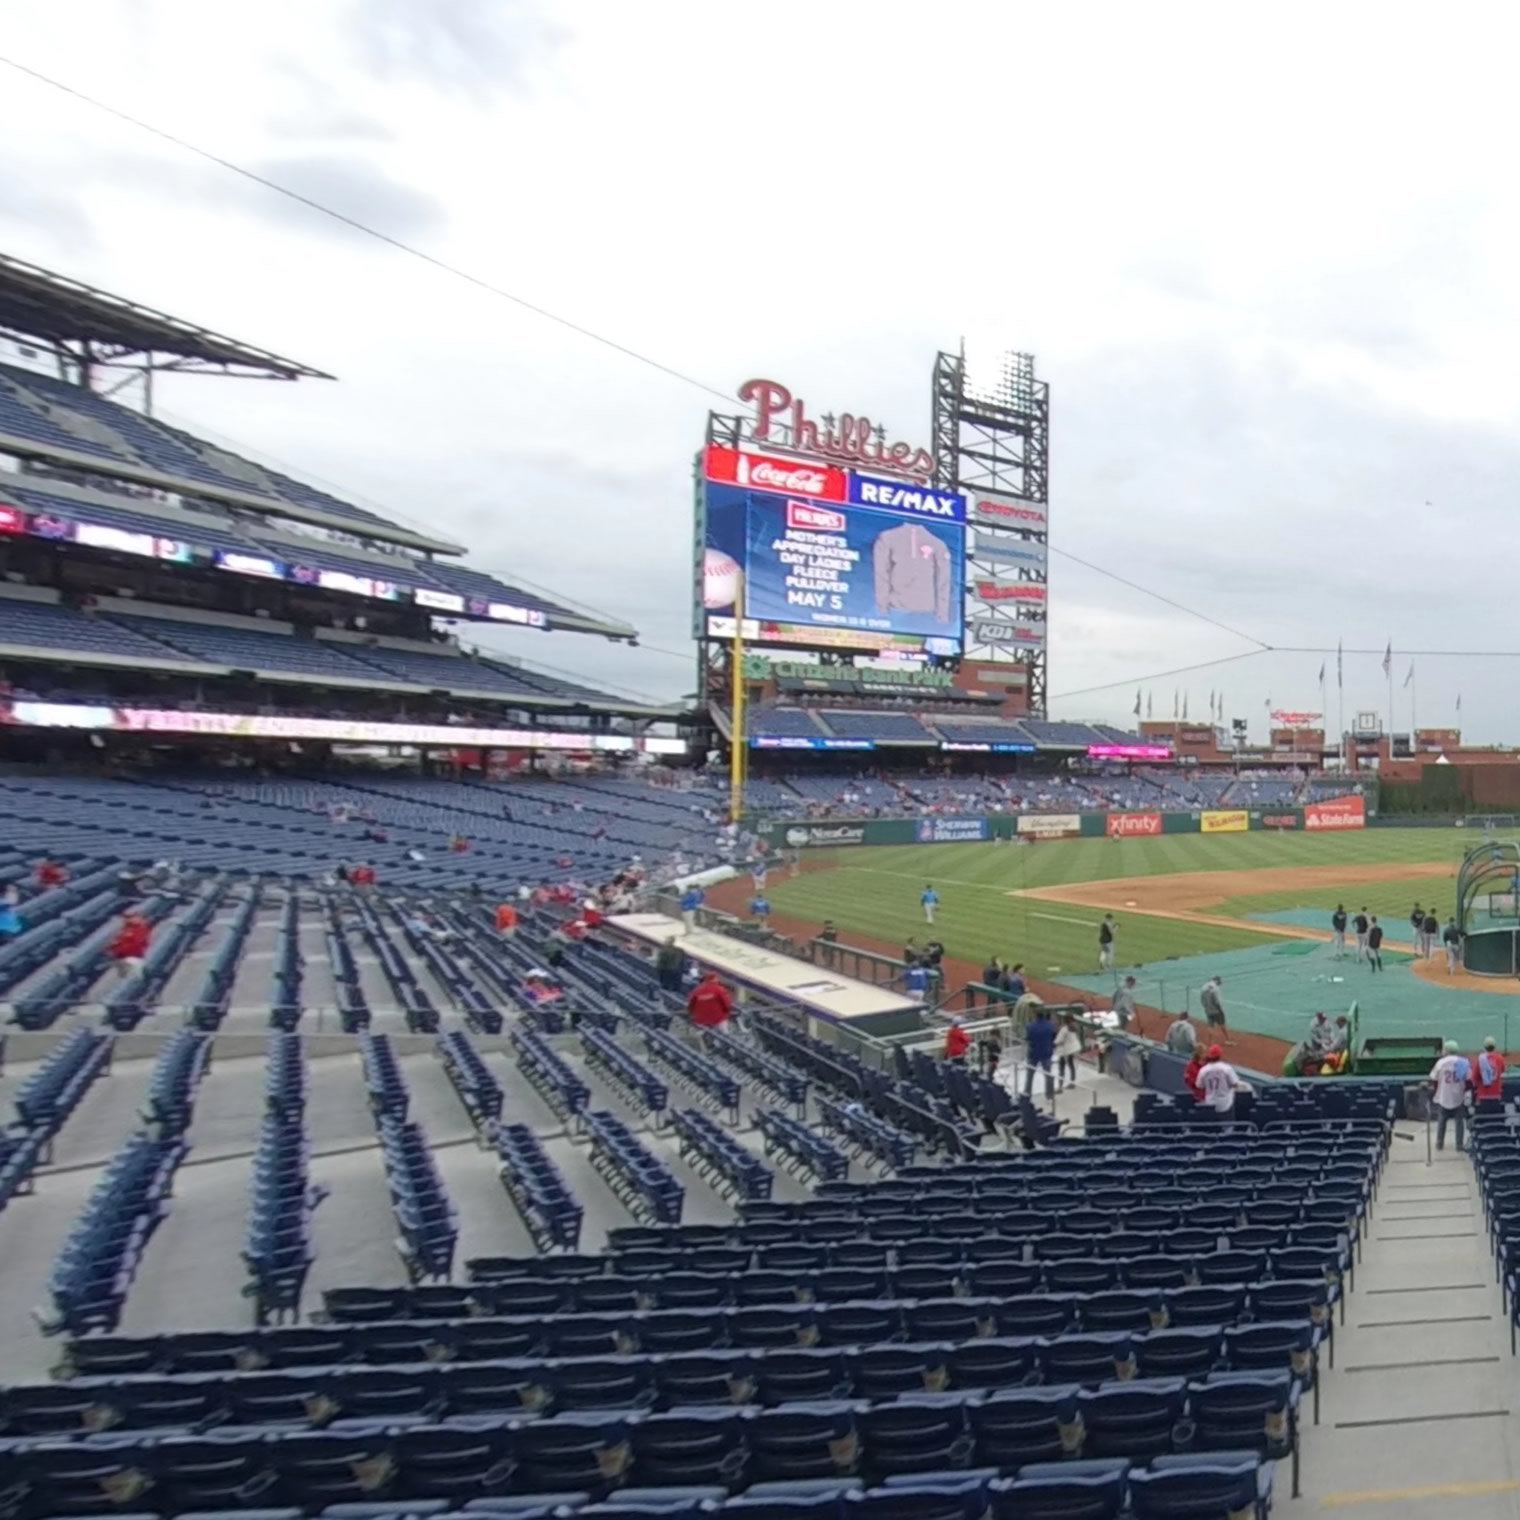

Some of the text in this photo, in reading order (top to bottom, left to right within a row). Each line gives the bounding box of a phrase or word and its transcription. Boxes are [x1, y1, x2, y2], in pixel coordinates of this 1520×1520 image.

[737, 378, 936, 477] Phillies
[861, 482, 956, 517] RE/MAX
[786, 531, 847, 548] MOTHER'S
[772, 539, 860, 562] APPRECIATION
[780, 551, 852, 571] DAY LADIES
[793, 565, 838, 581] FLEECE
[785, 577, 849, 594] PULLOVER
[788, 591, 842, 610] MAY 5
[775, 661, 953, 688] Citizens Bank Park
[936, 819, 982, 830] SHERWIN
[1110, 814, 1158, 836] xfinity
